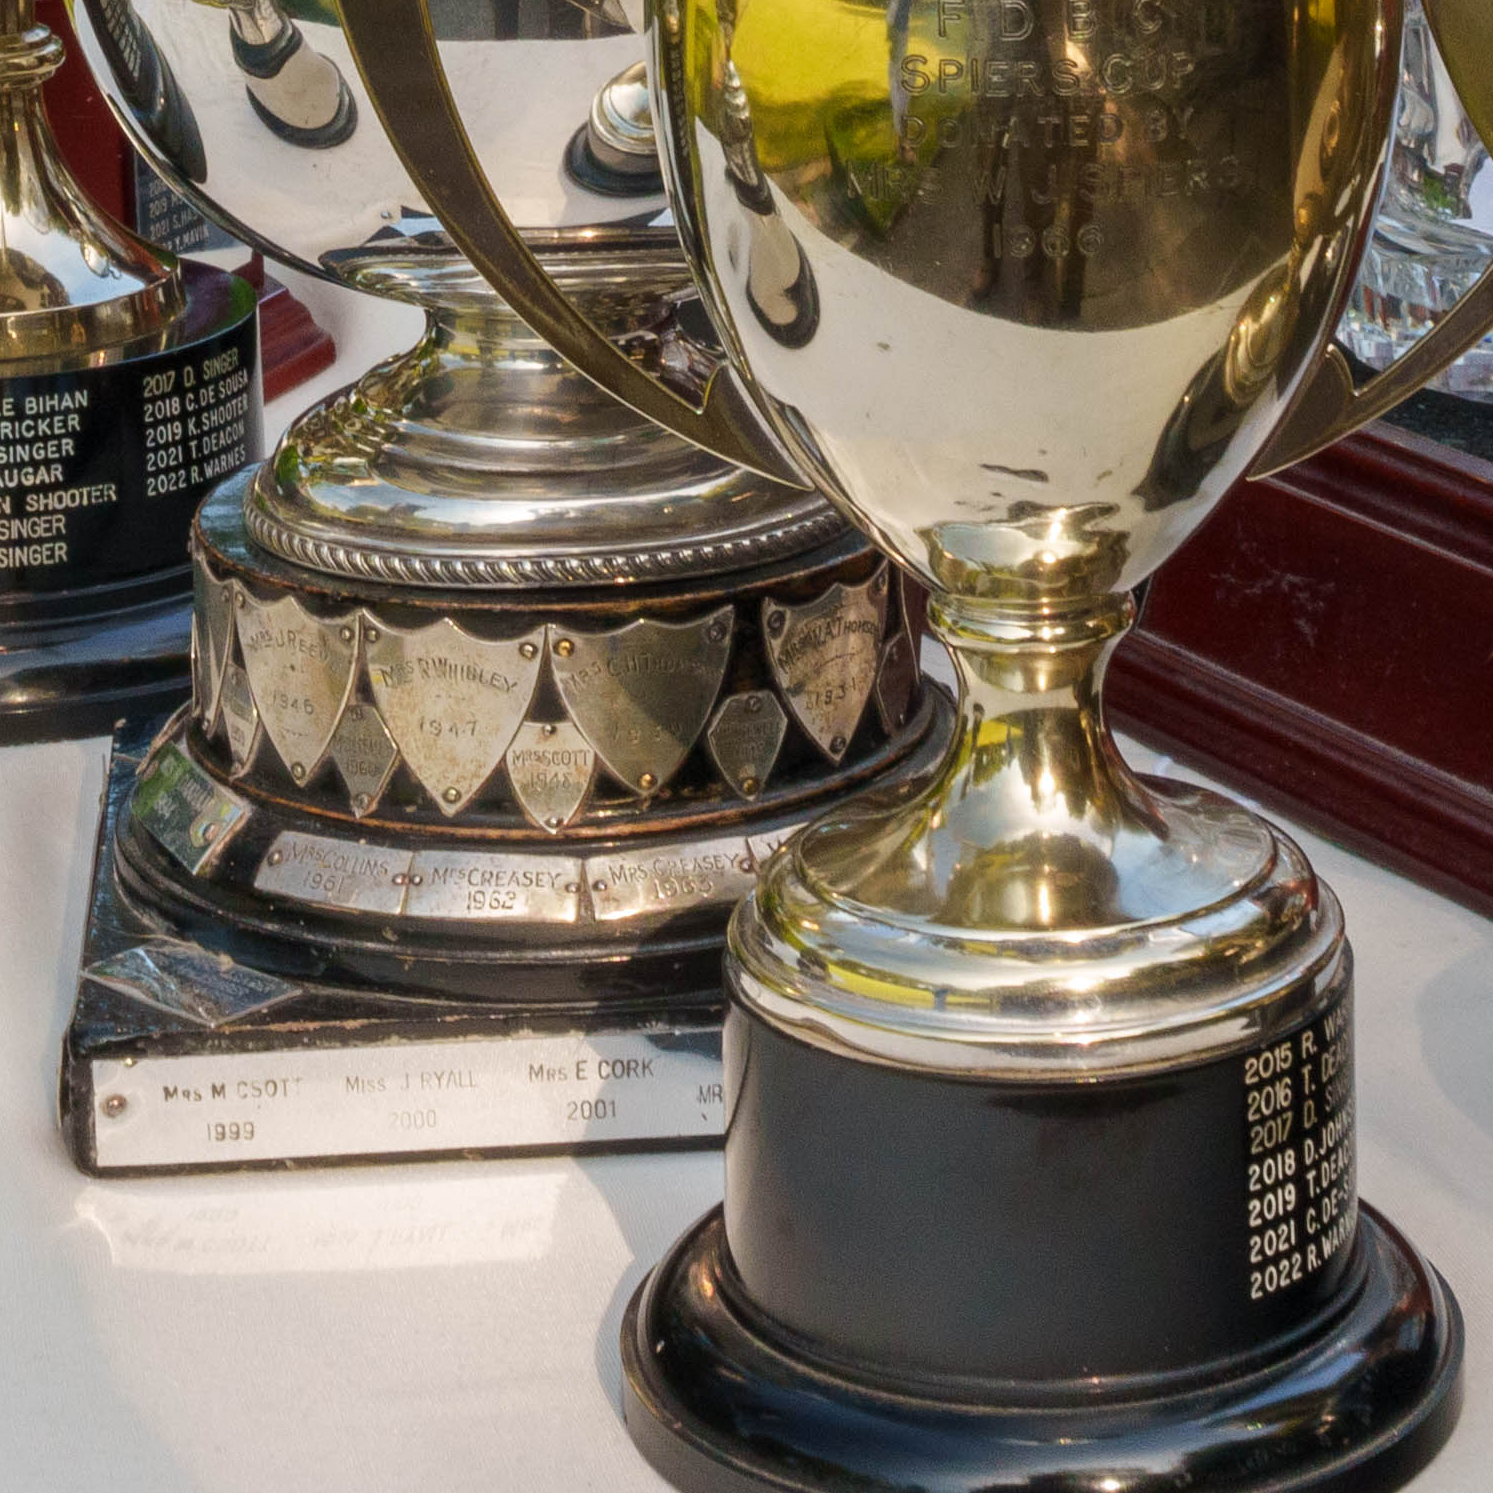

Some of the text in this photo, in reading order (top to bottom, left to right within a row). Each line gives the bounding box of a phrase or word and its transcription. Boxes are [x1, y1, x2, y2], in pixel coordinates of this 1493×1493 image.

[900, 50, 1198, 98] SPIERS CUP
[901, 105, 1195, 150] DONATED BY
[143, 347, 239, 398] 2017 SINGER
[25, 389, 89, 415] BIHAN
[144, 368, 250, 423] 2018 SOUSA
[145, 421, 183, 448] 2019
[146, 445, 183, 472] 2021
[25, 482, 118, 512] SHOOTER
[147, 469, 188, 497] 2022
[466, 867, 563, 889] CREASEY
[466, 890, 517, 912] 1962
[575, 1057, 655, 1081] E CORK
[1245, 1041, 1293, 1086] 2015
[211, 1082, 227, 1100] M
[420, 1069, 480, 1091] RYALL
[566, 1099, 617, 1121] 2001
[1247, 1076, 1293, 1123] 2016
[206, 1121, 256, 1143] 1999
[387, 1108, 438, 1131] 2000
[1250, 1110, 1294, 1156] 2017
[1248, 1148, 1296, 1192] 2018
[1248, 1182, 1297, 1228] 2019
[1249, 1218, 1297, 1264] 2021
[1250, 1252, 1303, 1300] 2022
